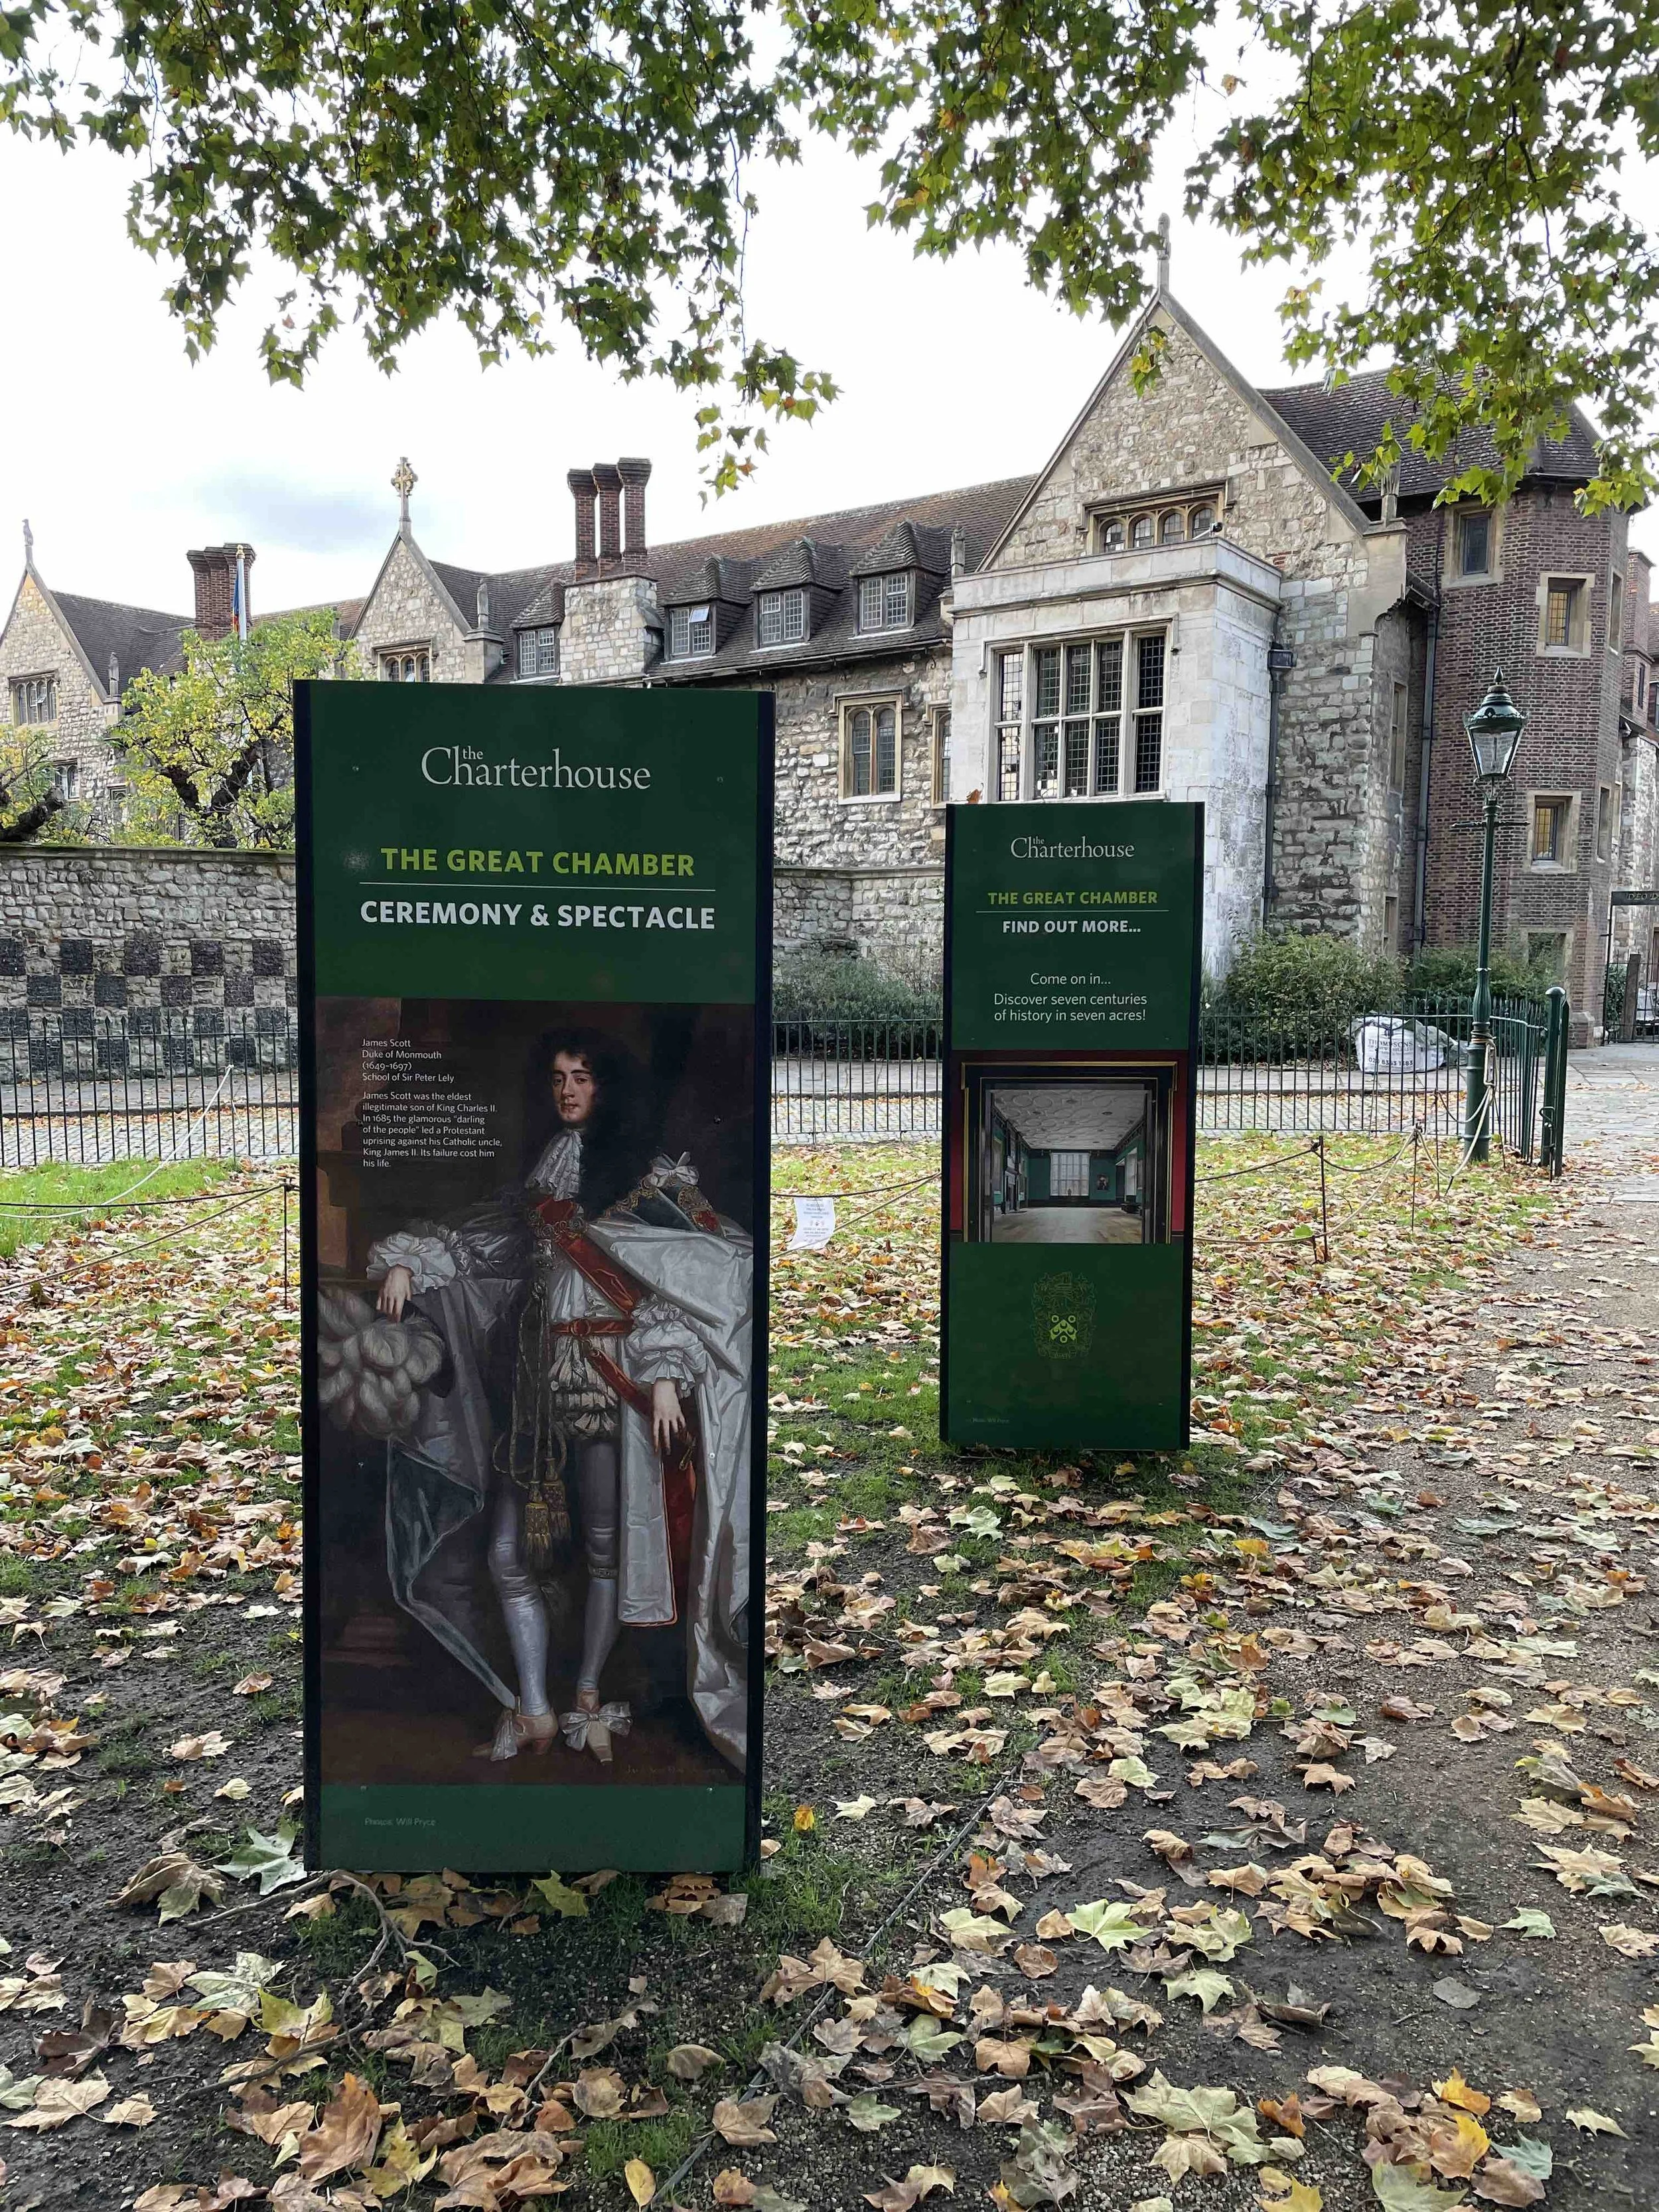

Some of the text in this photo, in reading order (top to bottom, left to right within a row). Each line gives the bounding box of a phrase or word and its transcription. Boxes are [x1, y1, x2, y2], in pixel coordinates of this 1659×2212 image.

[421, 745, 651, 790] the Charterhouse
[1011, 836, 1135, 858] Charterhouse
[380, 848, 695, 877] THE GREAT CHAMBER
[987, 891, 1157, 905] THE GREAT CHAMBER
[360, 901, 715, 929] CEREMONY & SPECTACLE
[1003, 920, 1141, 933] FIND OUT MORE...
[1030, 972, 1111, 985] Come on in...
[994, 993, 1147, 1005] Discover seven centuries
[994, 1009, 1145, 1023] of history in seven acres!
[390, 1039, 411, 1047] Scott
[396, 1051, 442, 1059] Monmouth
[362, 1072, 390, 1081] School
[401, 1073, 413, 1082] Sir
[438, 1074, 455, 1083] Lely
[362, 1091, 389, 1100] James
[390, 1092, 411, 1100] Scott
[447, 1092, 472, 1101] eldest
[362, 1102, 408, 1112] illegitimate
[437, 1104, 455, 1114] King
[457, 1104, 488, 1112] Charles
[372, 1114, 392, 1124] 1685
[408, 1115, 451, 1124] glamorous
[421, 1126, 434, 1134] led
[363, 1137, 396, 1146] uprising
[397, 1138, 427, 1147] against
[478, 1138, 502, 1147] uncle,
[363, 1147, 382, 1157] King
[384, 1148, 409, 1157] James
[363, 1159, 375, 1167] his
